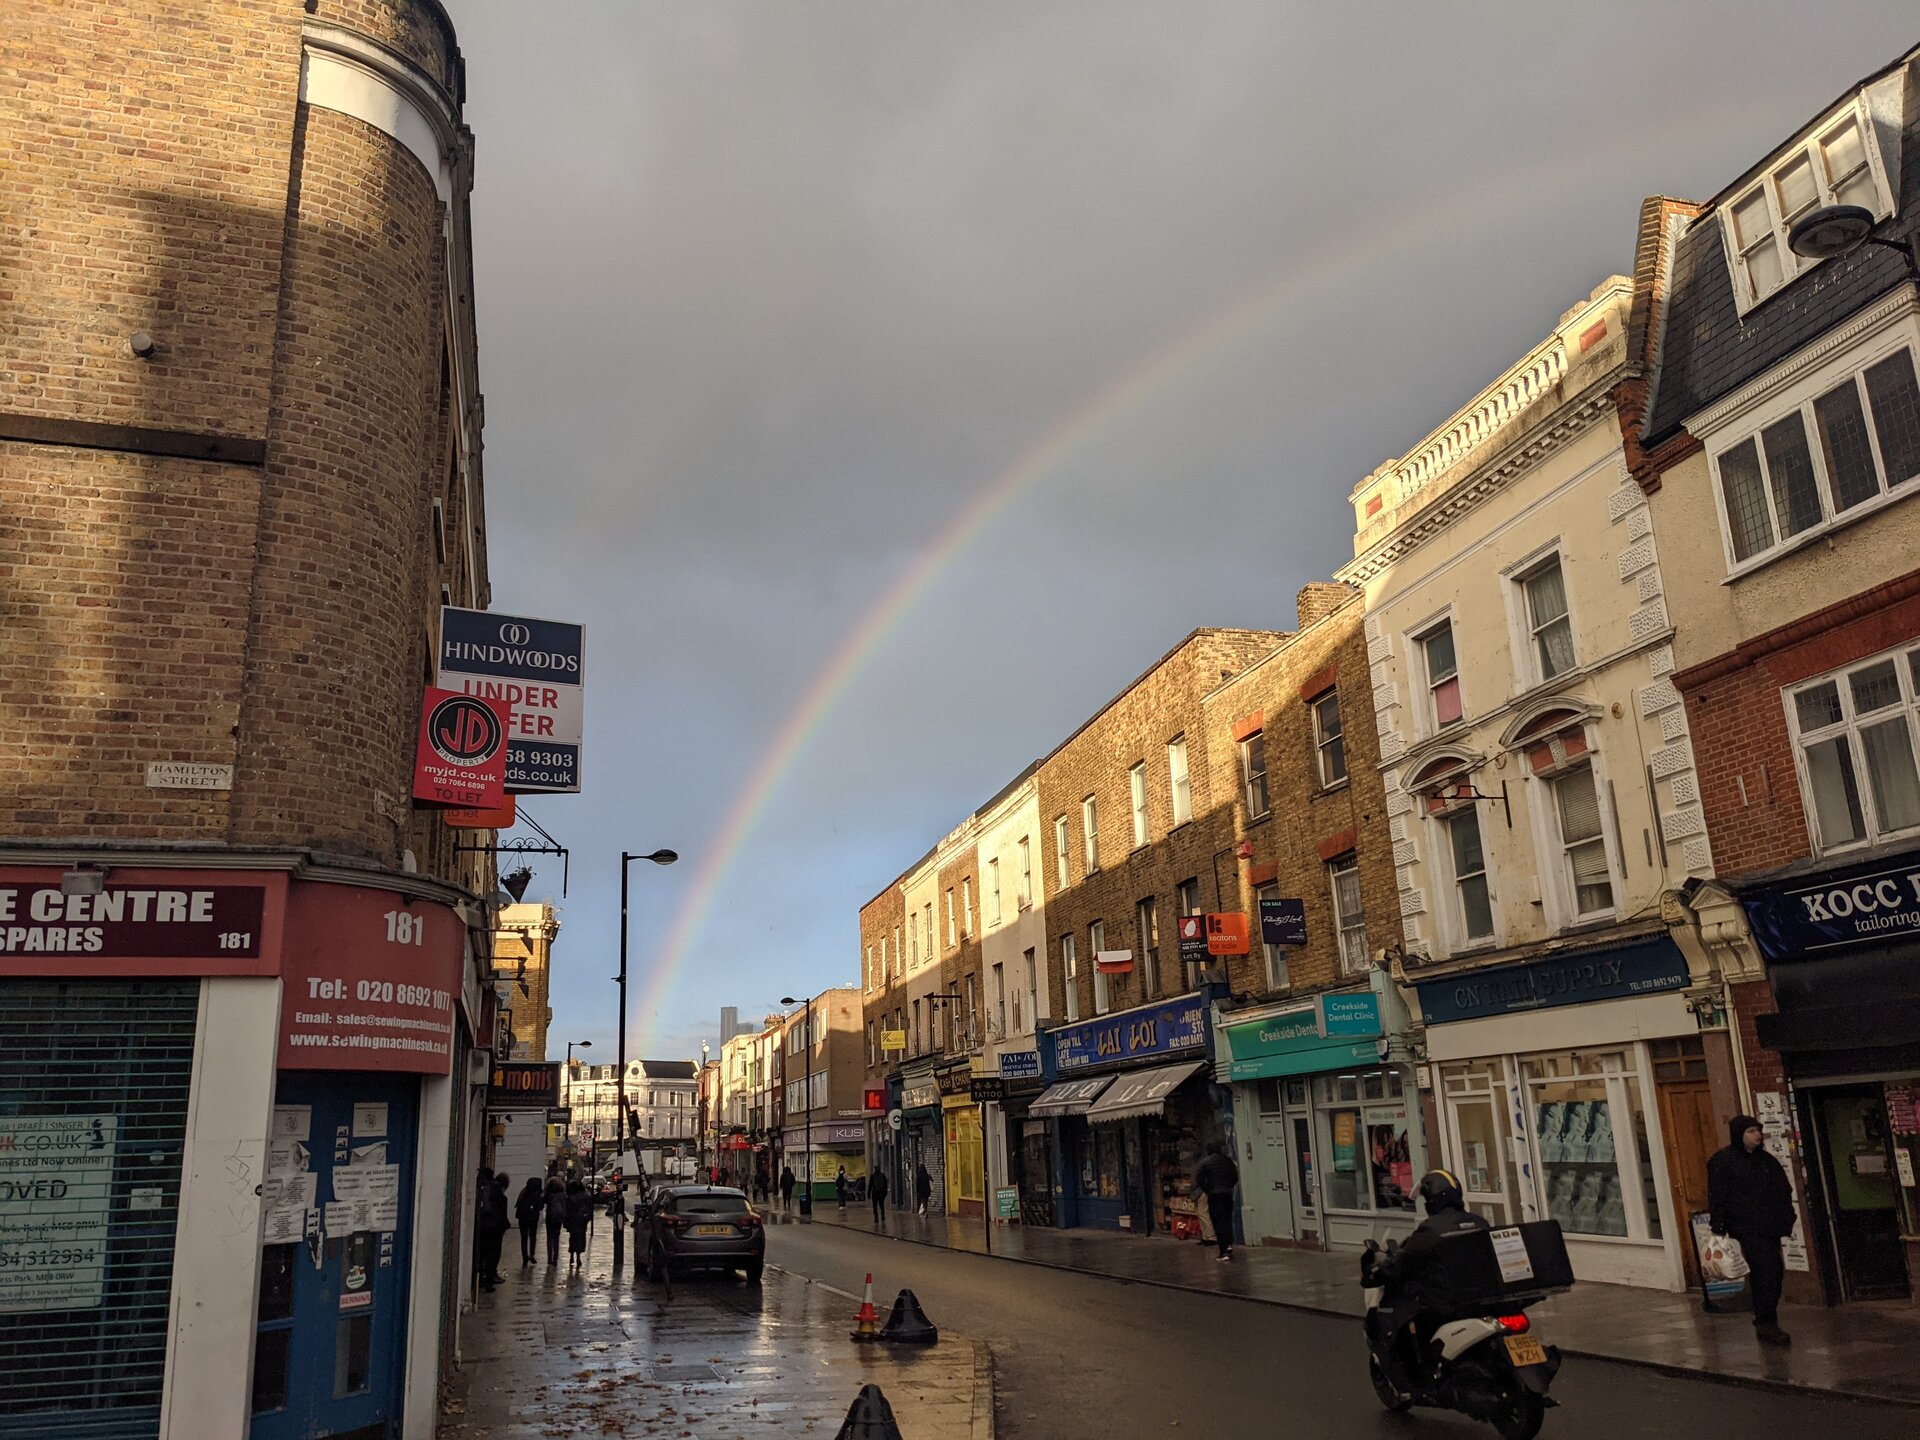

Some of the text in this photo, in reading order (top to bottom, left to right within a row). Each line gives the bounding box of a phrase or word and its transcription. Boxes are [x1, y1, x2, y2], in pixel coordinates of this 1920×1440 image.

[445, 640, 579, 673] HINDWOODS
[463, 679, 559, 710] UNDER
[509, 712, 555, 737] FER
[438, 748, 487, 767] PROPERTY
[531, 750, 574, 767] 9303
[154, 765, 229, 775] HAMILTON
[424, 764, 497, 783] myjd.co.uk
[159, 776, 220, 787] STREET
[433, 776, 486, 791] 020 7064 6896
[434, 787, 483, 804] TO LET
[30, 889, 215, 923] CENTRE
[1800, 879, 1903, 923] KOCC
[384, 910, 424, 947] 181
[1854, 910, 1920, 933] tailoring
[217, 932, 251, 950] 181
[1540, 959, 1624, 996] SUPPLY
[1642, 979, 1653, 989] 020
[307, 976, 451, 1011] Tel: 020 8692 1077
[1331, 1002, 1369, 1012] Creekside
[295, 1011, 333, 1024] Email:
[1328, 1011, 1375, 1023] Dental Clinic
[1058, 1037, 1071, 1050] OPEN
[1071, 1035, 1082, 1048] TILL
[1097, 1019, 1157, 1057] LAI LOI
[1259, 1026, 1295, 1043] Creekside
[1058, 1048, 1070, 1060] LATE
[974, 1091, 1003, 1099] TATTOO
[50, 1121, 84, 1130] SINGER
[41, 1157, 64, 1167] Now
[27, 1248, 95, 1266] 312934
